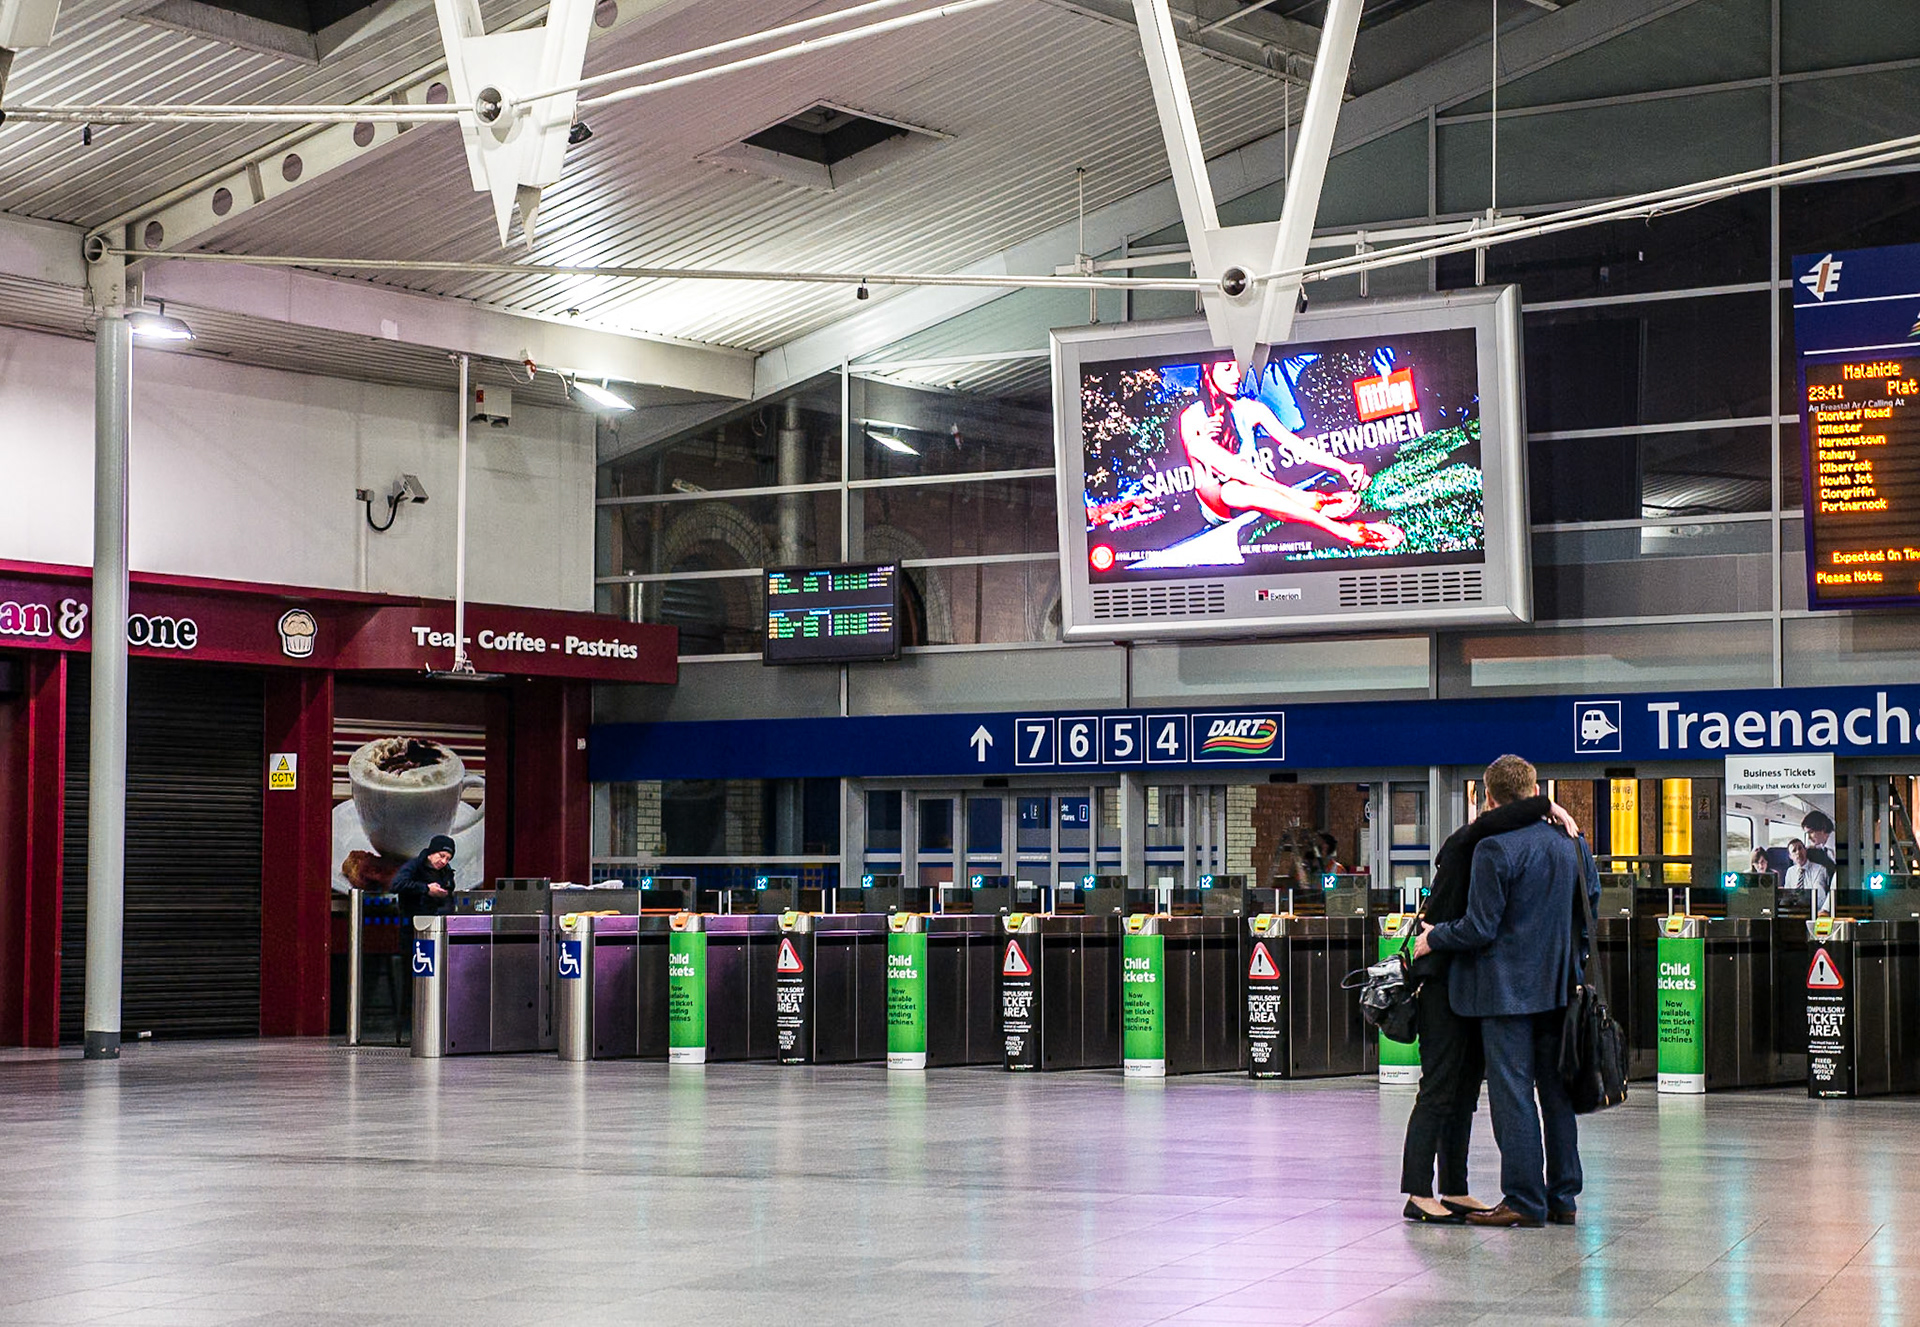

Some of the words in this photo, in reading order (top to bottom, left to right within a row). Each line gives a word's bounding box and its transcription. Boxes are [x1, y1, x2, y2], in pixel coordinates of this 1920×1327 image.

[1843, 361, 1901, 379] Malahide
[1808, 385, 1844, 402] 23:41
[1887, 378, 1919, 396] Plat
[1808, 404, 1819, 413] Ag
[1820, 402, 1850, 411] Freastal
[1851, 401, 1860, 409] Ar
[1868, 399, 1893, 408] Calling
[1895, 398, 1905, 406] At
[1817, 409, 1862, 422] Clontarf
[1863, 406, 1892, 419] Road
[1817, 423, 1863, 435] Killester
[1818, 434, 1887, 448] Harmonstown
[1820, 474, 1852, 487] Howth
[1820, 486, 1877, 500] Clongriffin
[1887, 548, 1902, 562] On
[1903, 547, 1920, 561] Tim
[1816, 572, 1852, 585] Please
[1853, 570, 1883, 583] Note:
[1270, 592, 1299, 601] Exterion
[58, 598, 88, 639] &
[127, 614, 198, 649] one
[411, 626, 457, 648] Tea
[478, 629, 546, 652] Coffee
[565, 635, 638, 659] Pastries
[1026, 725, 1046, 759] 7
[1069, 723, 1089, 758] 6
[1114, 723, 1133, 757] 5
[1156, 722, 1179, 756] 4
[1207, 719, 1267, 736] DART
[271, 772, 295, 783] CCTV
[1743, 769, 1782, 778] Business
[1784, 768, 1816, 777] Tickets
[1612, 785, 1621, 794] ew
[1733, 783, 1764, 791] Flexibility
[1812, 782, 1827, 790] you!
[888, 954, 912, 966] Child
[1124, 957, 1151, 970] Child
[669, 965, 695, 977] ckets
[887, 967, 918, 979] ickets
[1660, 962, 1690, 976] Child
[1123, 970, 1156, 983] ickets
[1004, 1007, 1029, 1018] AREA
[1249, 1012, 1277, 1023] AREA
[1807, 1013, 1845, 1026] TICKET
[1660, 1027, 1691, 1036] vending
[1809, 1025, 1841, 1037] AREA
